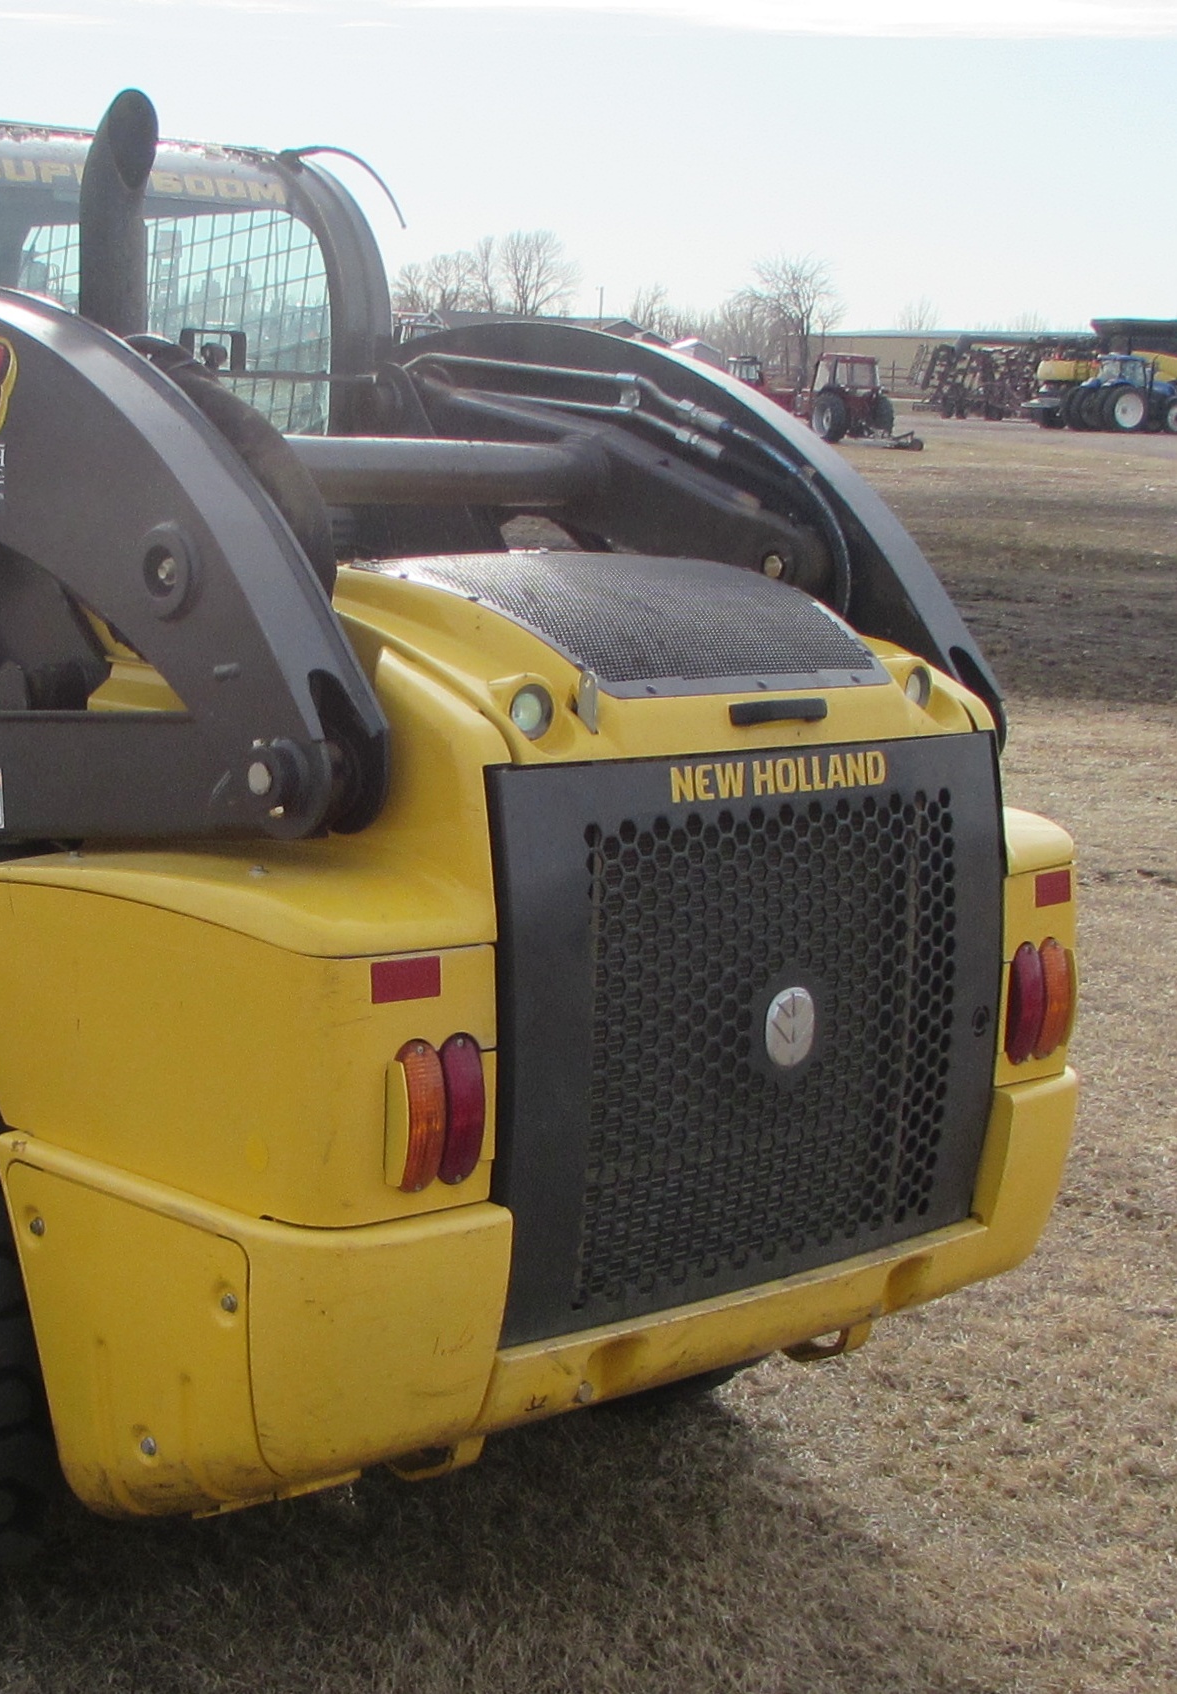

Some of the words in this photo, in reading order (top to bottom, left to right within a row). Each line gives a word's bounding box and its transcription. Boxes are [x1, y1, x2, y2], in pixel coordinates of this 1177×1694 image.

[150, 170, 287, 204] BOOM
[670, 762, 745, 803] NEW
[752, 751, 887, 797] HOLLAND
